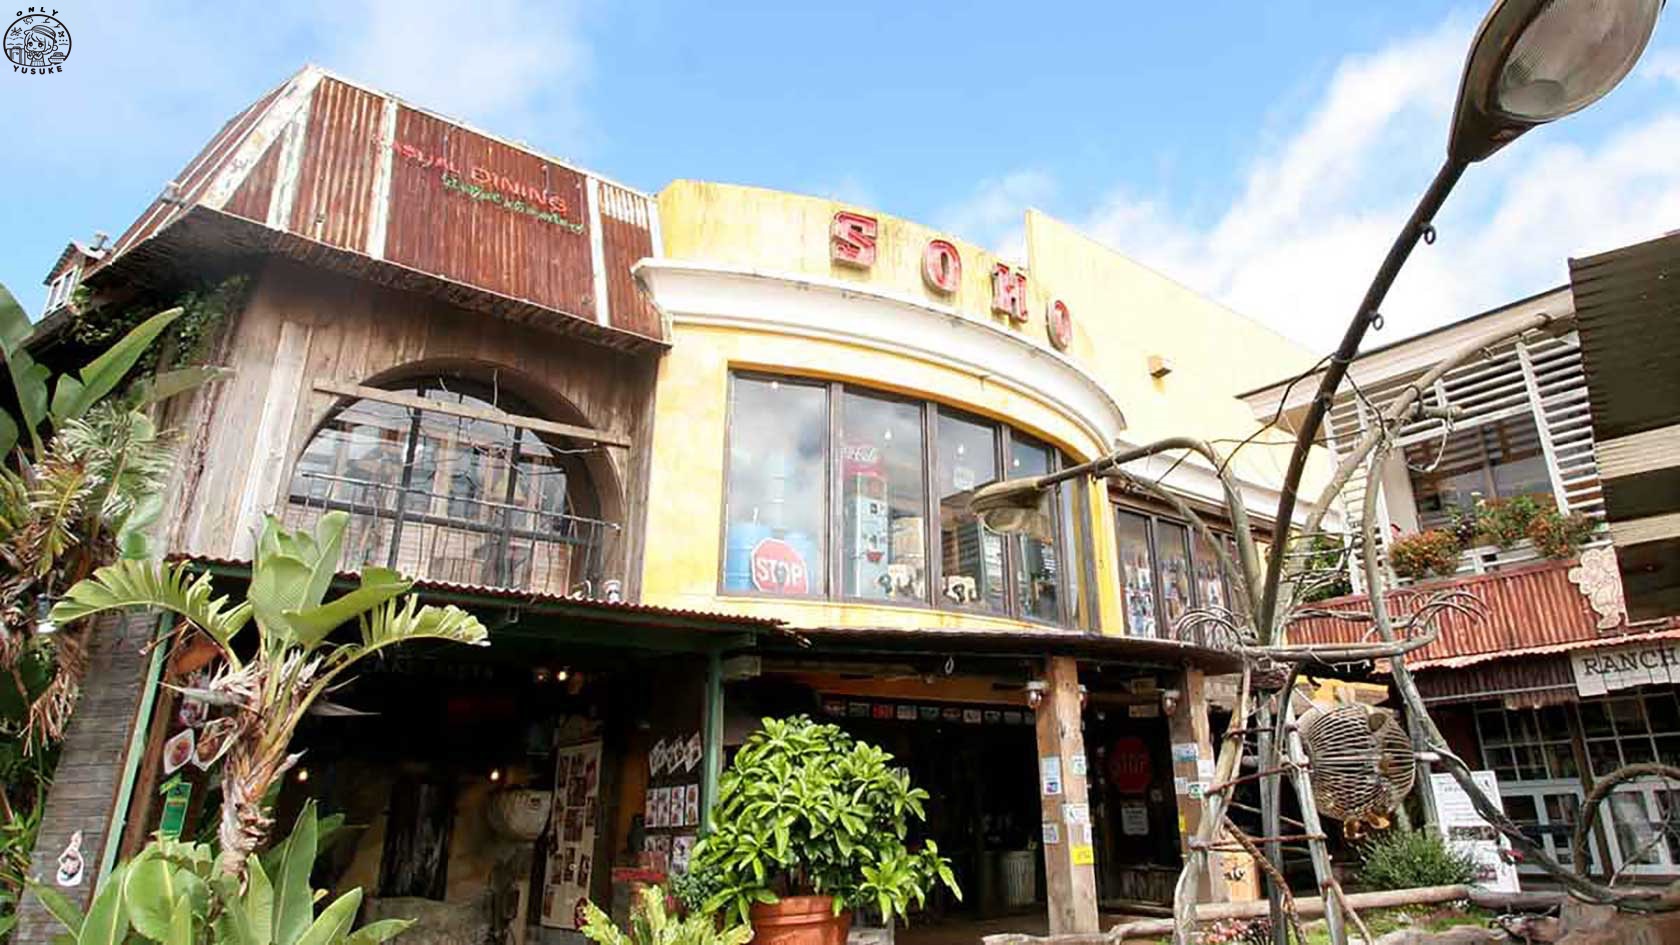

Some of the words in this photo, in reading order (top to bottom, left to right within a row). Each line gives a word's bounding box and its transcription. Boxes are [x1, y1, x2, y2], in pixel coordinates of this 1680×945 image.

[376, 134, 460, 173] SUAL
[471, 166, 568, 215] DINING
[829, 210, 1072, 351] SOHO
[756, 558, 806, 585] STOP
[1582, 647, 1678, 675] RANCH
